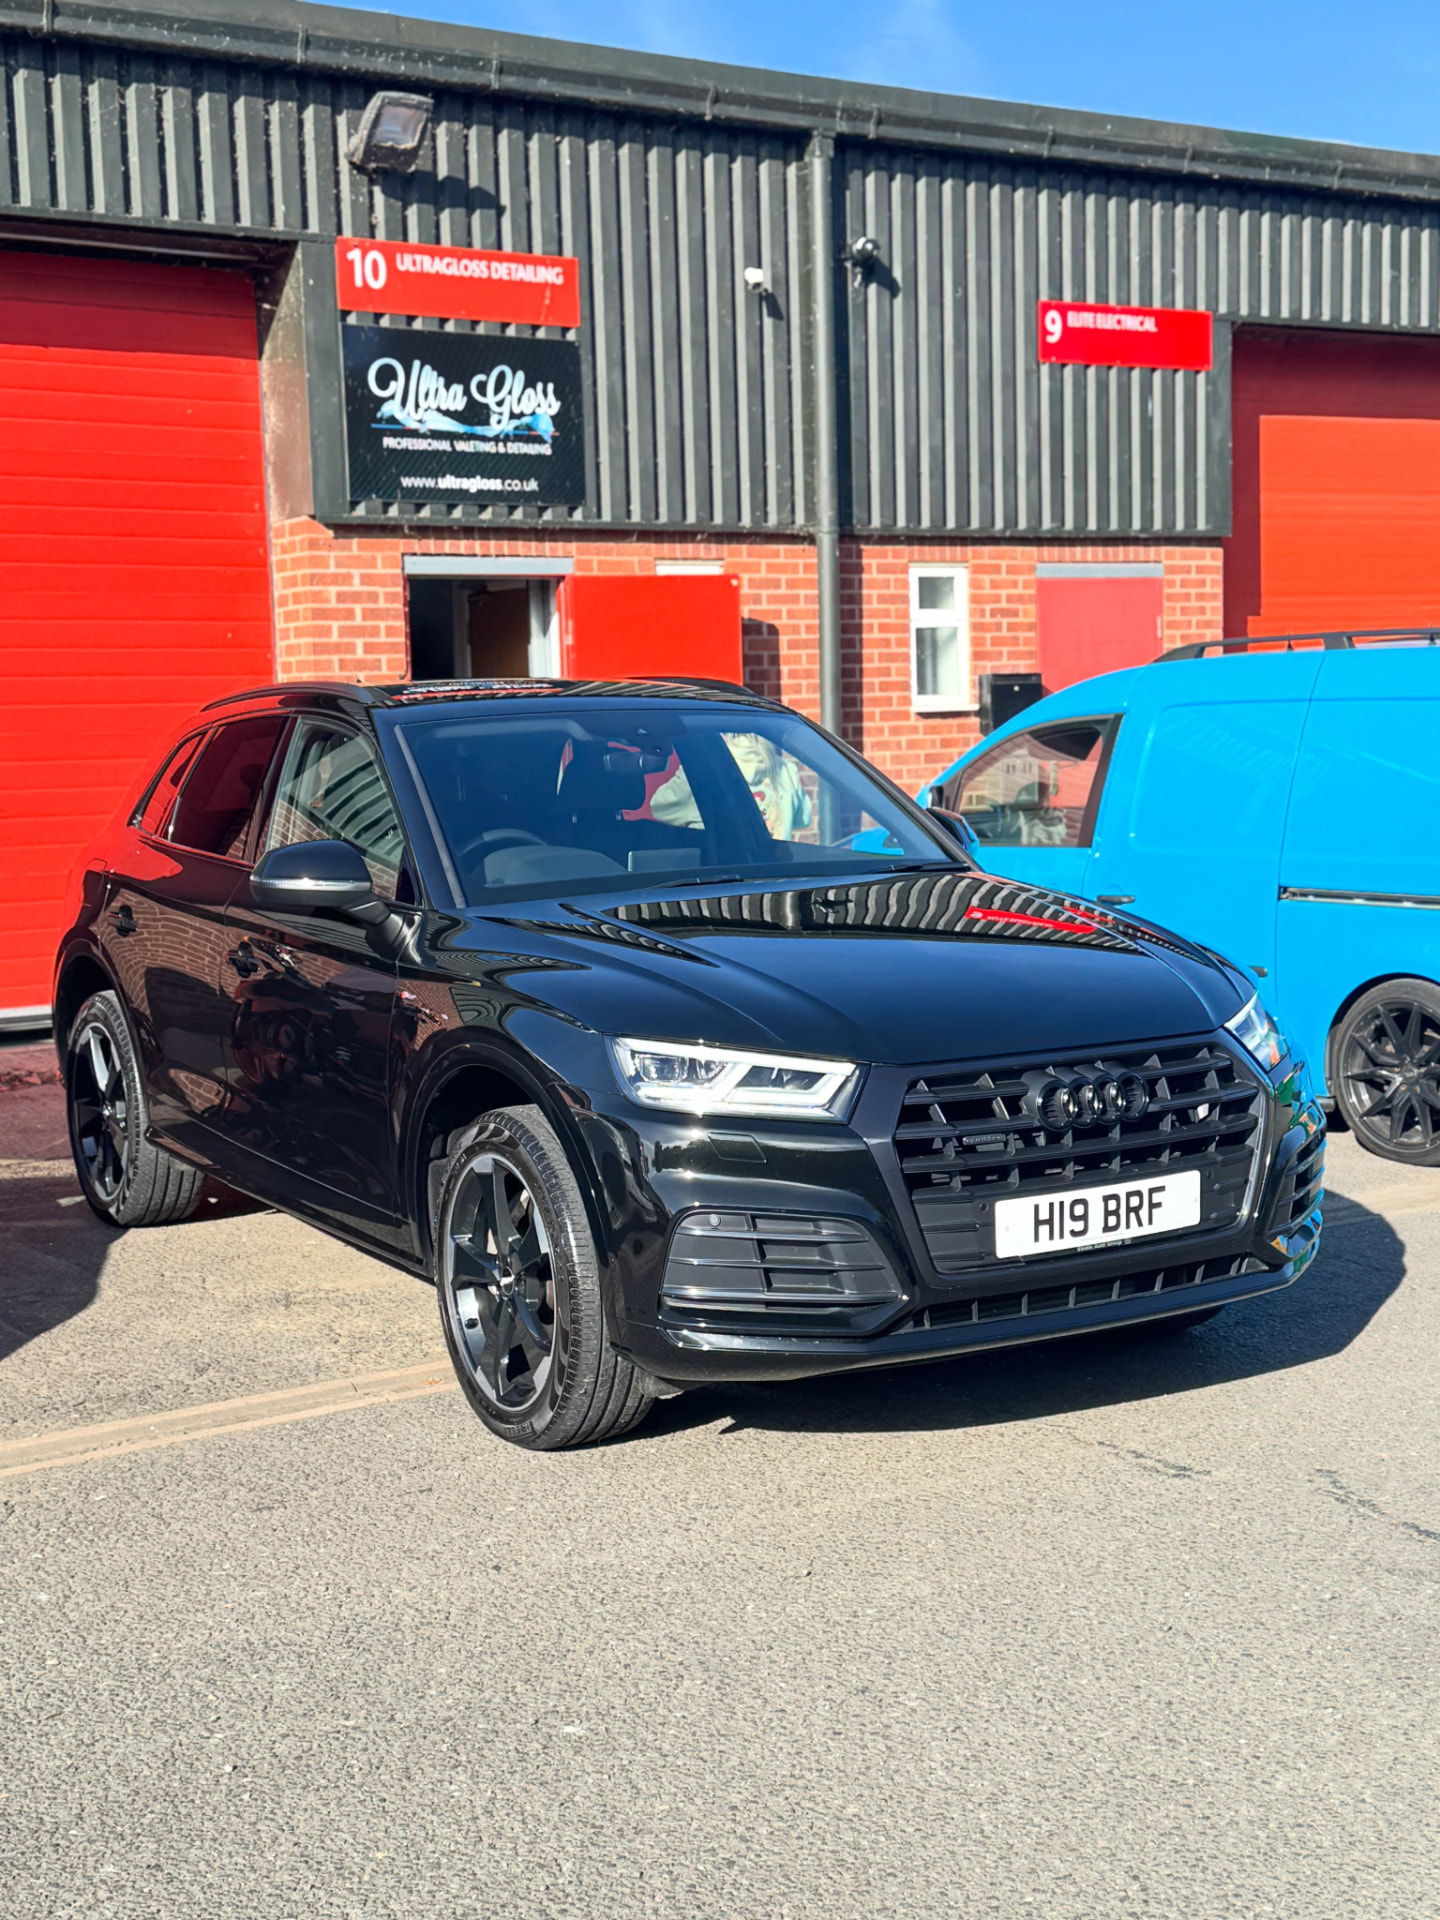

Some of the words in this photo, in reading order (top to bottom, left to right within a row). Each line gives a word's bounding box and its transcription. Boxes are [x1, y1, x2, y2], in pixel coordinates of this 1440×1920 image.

[346, 248, 387, 290] 10
[396, 253, 489, 279] ULTRAGLOSS
[490, 263, 564, 285] DETAILING
[1044, 309, 1062, 344] 9
[1067, 311, 1095, 328] ELITE
[1096, 312, 1158, 333] ELECTRICAL
[367, 357, 468, 421] Ultra
[470, 364, 561, 431] Gloss
[382, 437, 452, 452] PROFESSIONAL
[453, 440, 497, 454] VALETING
[507, 442, 552, 456] DETAILING
[400, 474, 540, 493] www.ultragloss.co.uk
[1034, 1198, 1089, 1243] H19
[1102, 1185, 1166, 1234] BRF
